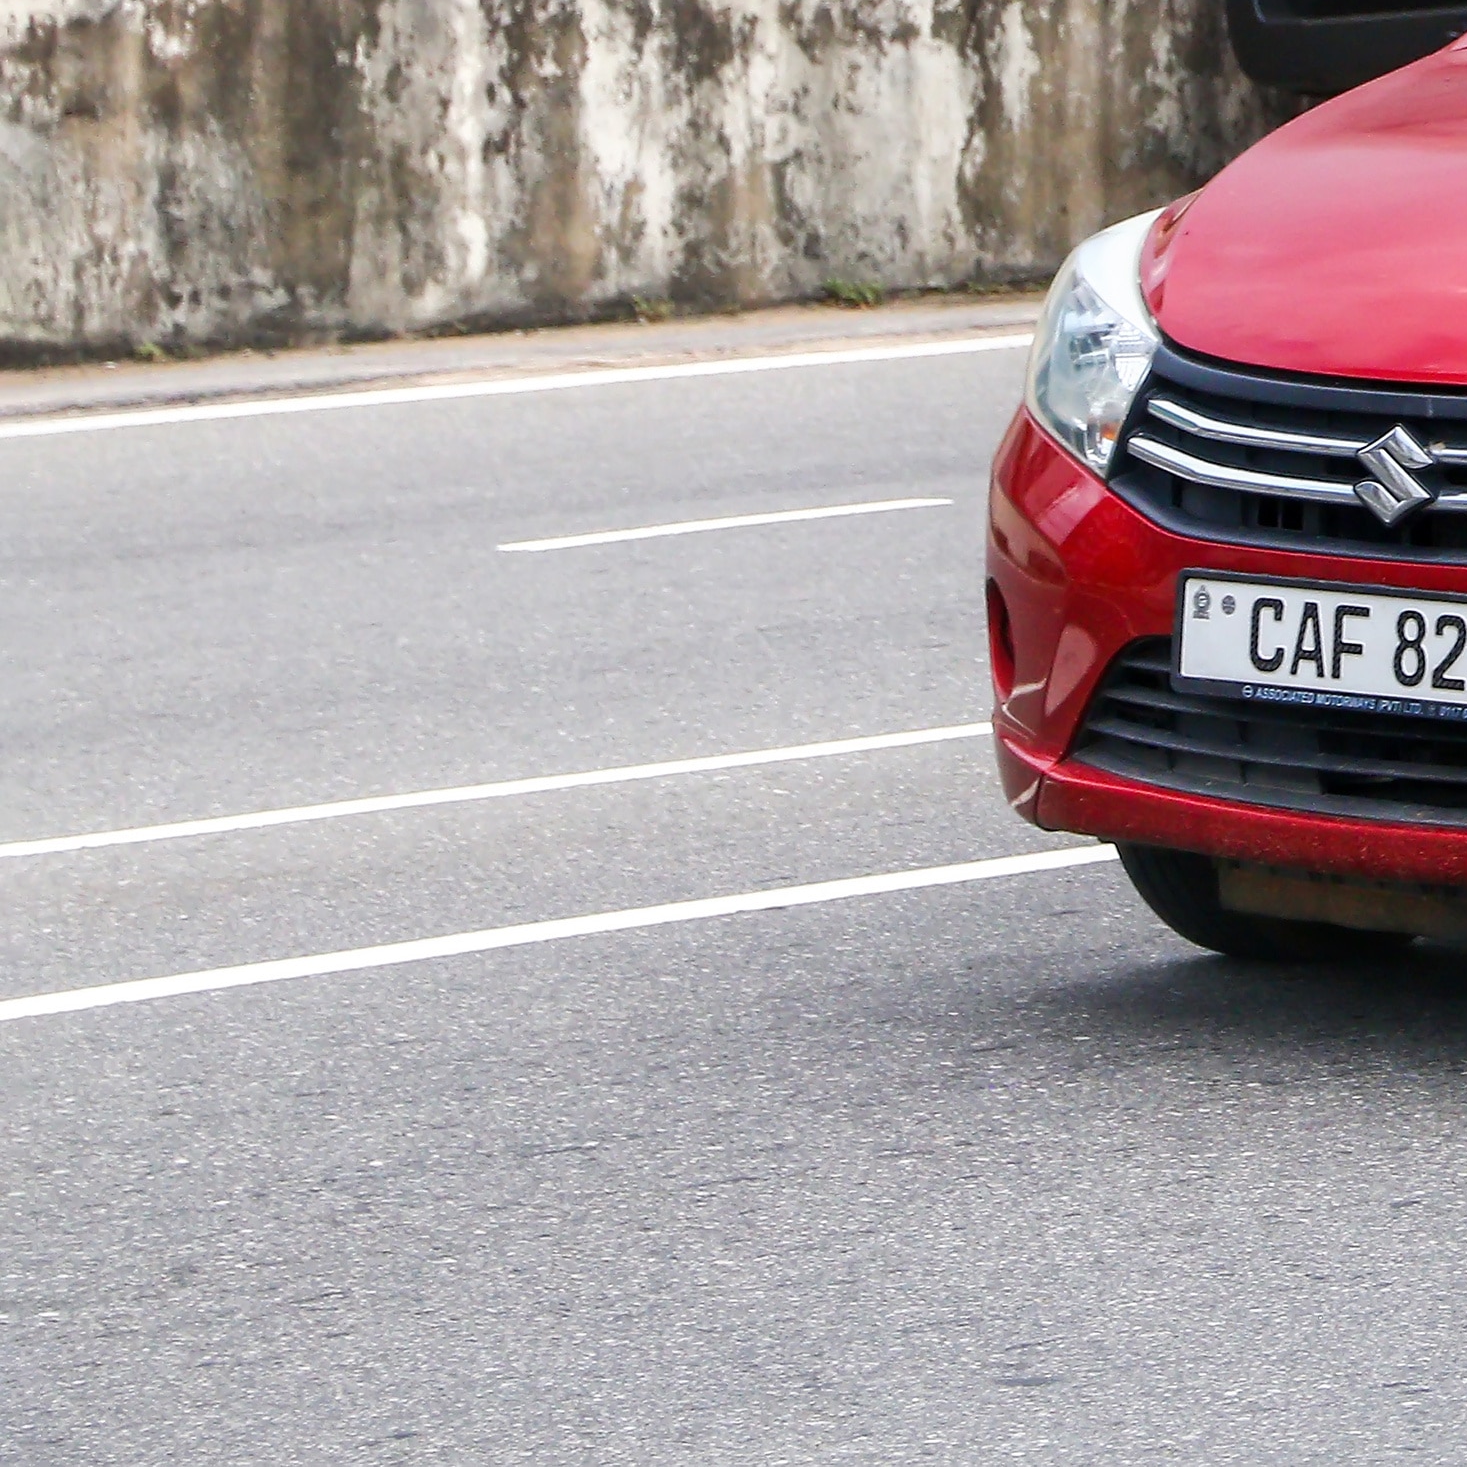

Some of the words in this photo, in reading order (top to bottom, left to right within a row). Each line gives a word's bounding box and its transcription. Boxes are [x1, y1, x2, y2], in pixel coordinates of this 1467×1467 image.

[1250, 596, 1371, 679] CAF
[1254, 686, 1315, 704] ASSOCIATED
[1316, 694, 1377, 710] MOTORWAYS
